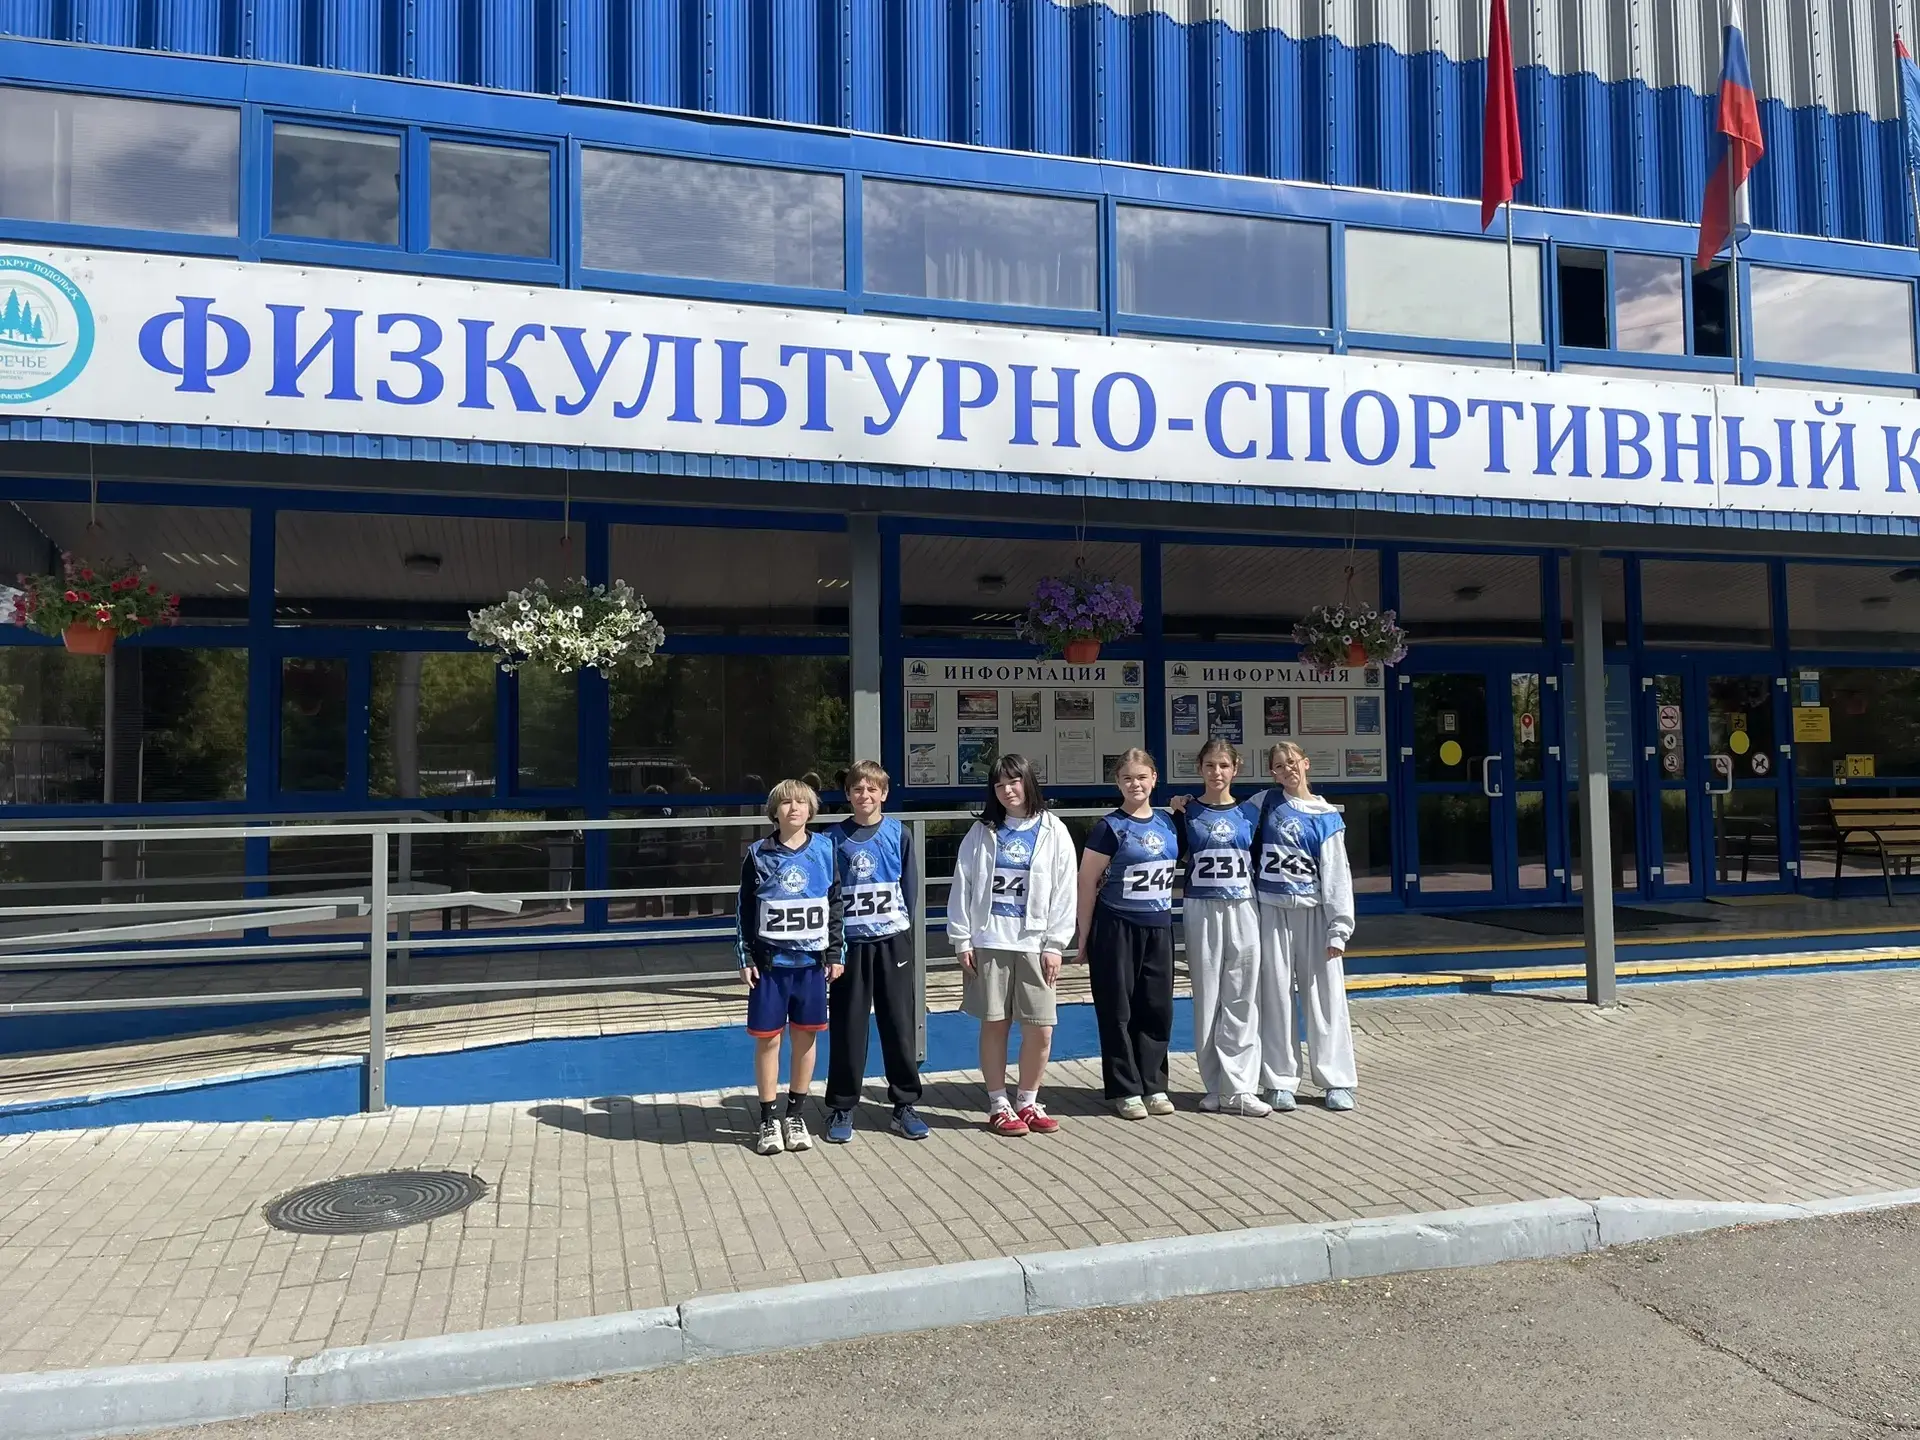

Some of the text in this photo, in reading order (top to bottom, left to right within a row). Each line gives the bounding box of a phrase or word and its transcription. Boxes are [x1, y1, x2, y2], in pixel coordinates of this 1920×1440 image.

[33, 263, 80, 301] ПОДОЛЬСК
[139, 296, 1857, 493] ФИЗКУЛЬТУРНО-СПОРТИВНЫЙ
[944, 665, 1106, 684] ИНФОРМАЦИЯ
[1203, 667, 1349, 684] ИНФОРМАЦИЯ
[1198, 856, 1248, 879] 231
[842, 890, 892, 917] 232
[766, 906, 824, 932] 250
